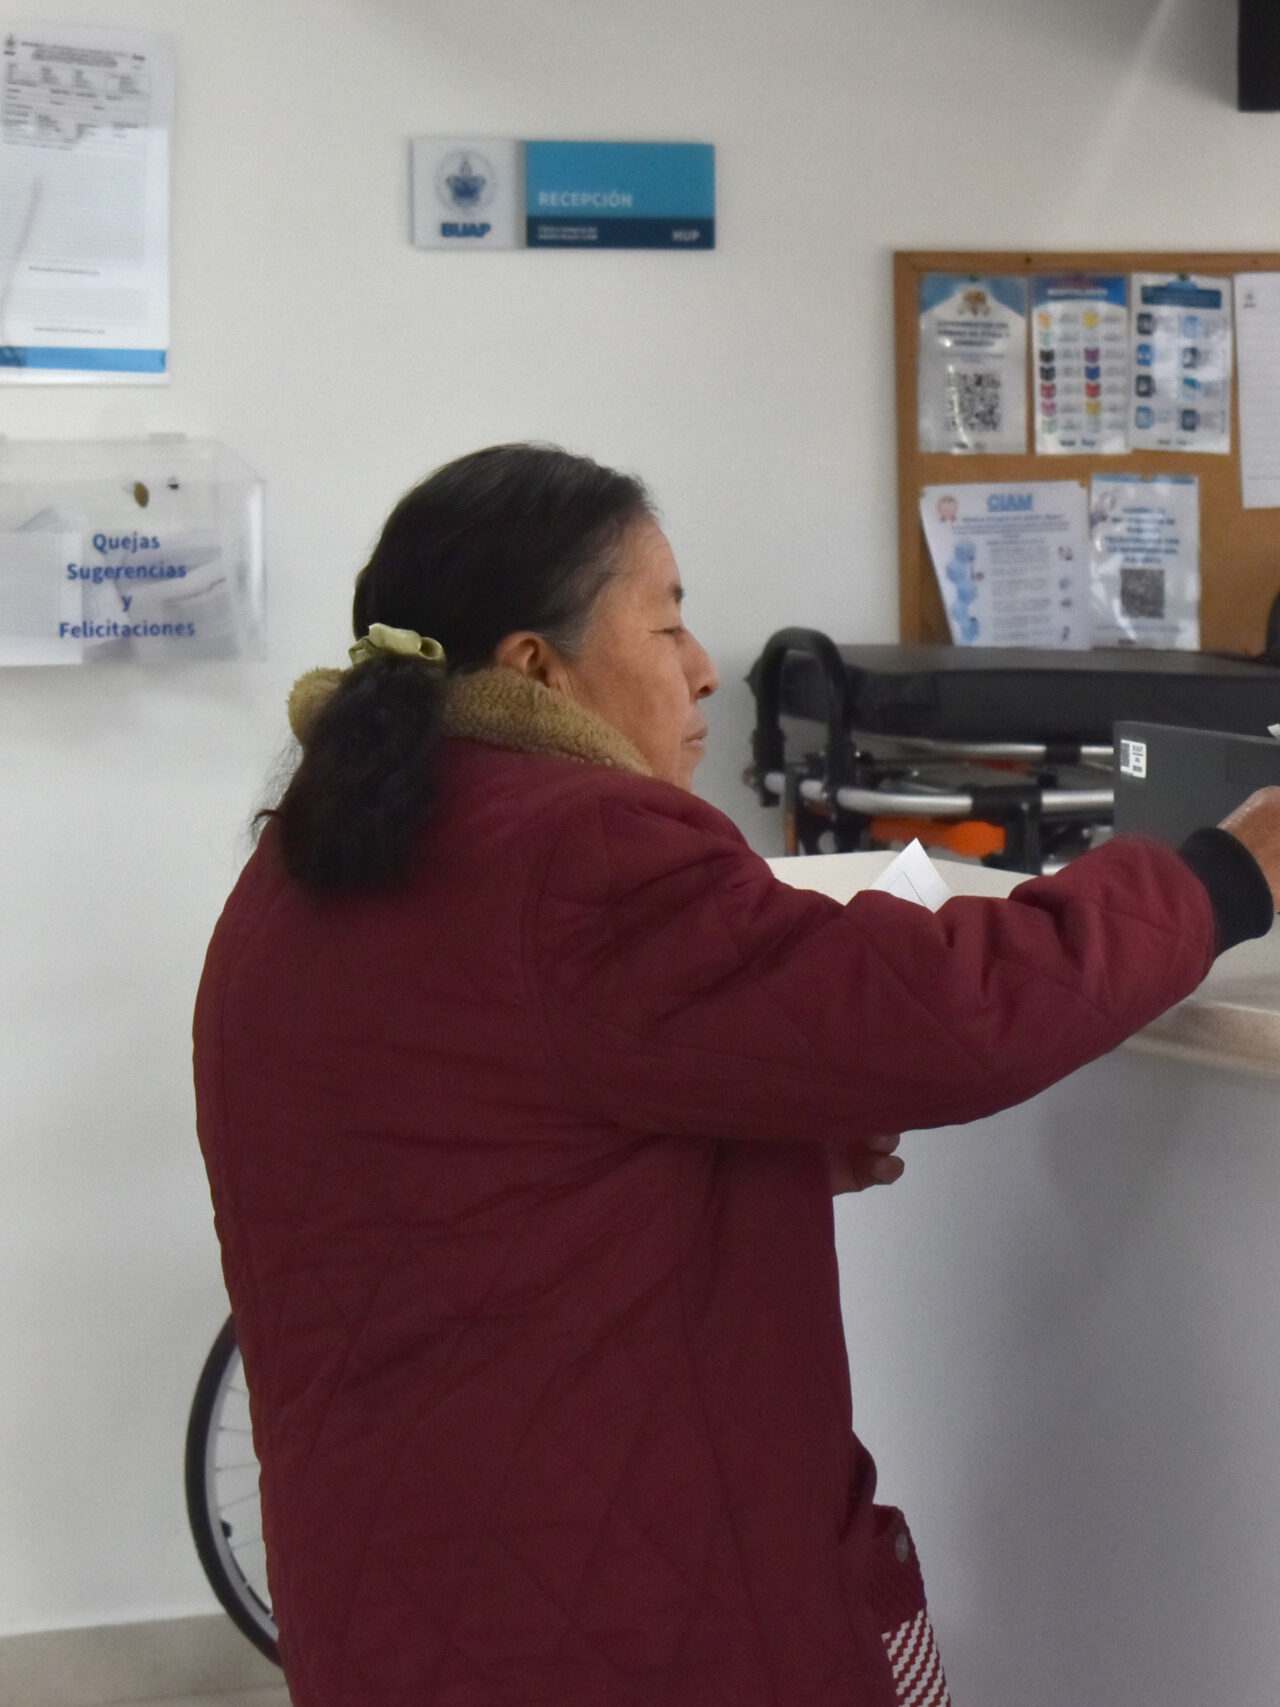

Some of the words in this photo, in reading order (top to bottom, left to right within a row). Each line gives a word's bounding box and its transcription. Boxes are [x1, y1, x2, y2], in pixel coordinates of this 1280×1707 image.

[538, 190, 633, 209] RECEPCIÓN
[440, 222, 492, 239] BUAP
[92, 532, 161, 553] Quejas
[66, 563, 188, 583] Sugerencias
[120, 595, 133, 612] y
[58, 620, 196, 639] Felicitaciones
